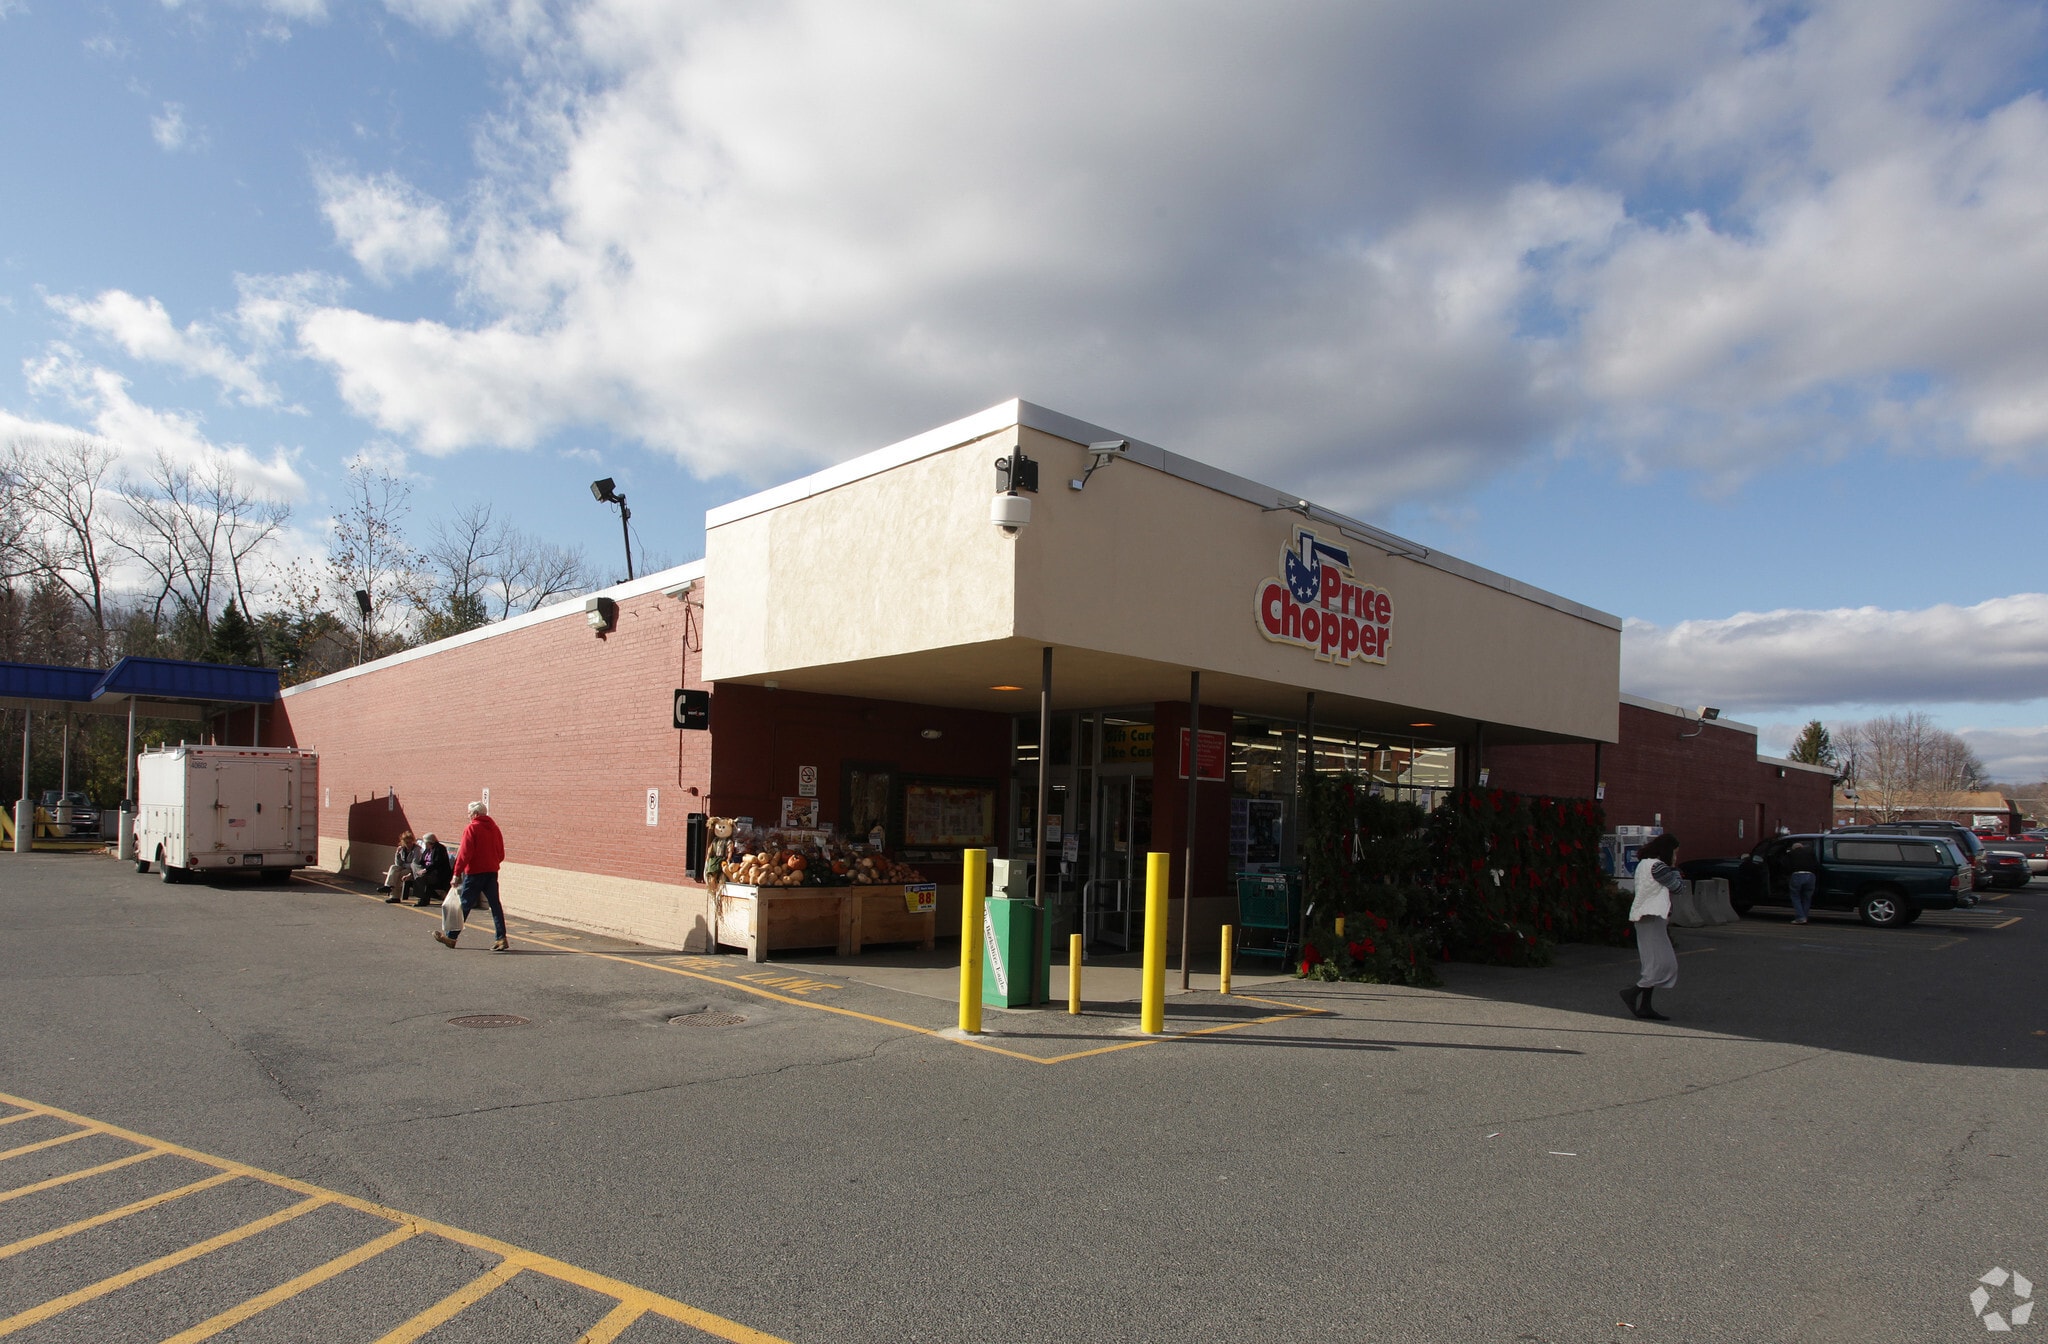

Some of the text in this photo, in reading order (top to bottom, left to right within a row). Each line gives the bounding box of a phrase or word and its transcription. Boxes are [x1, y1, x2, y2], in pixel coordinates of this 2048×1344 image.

[1261, 583, 1390, 659] Chopper
[1320, 564, 1391, 625] Price
[1130, 745, 1152, 757] Cas
[986, 925, 998, 966] Berkshire
[995, 966, 1005, 991] Eagle
